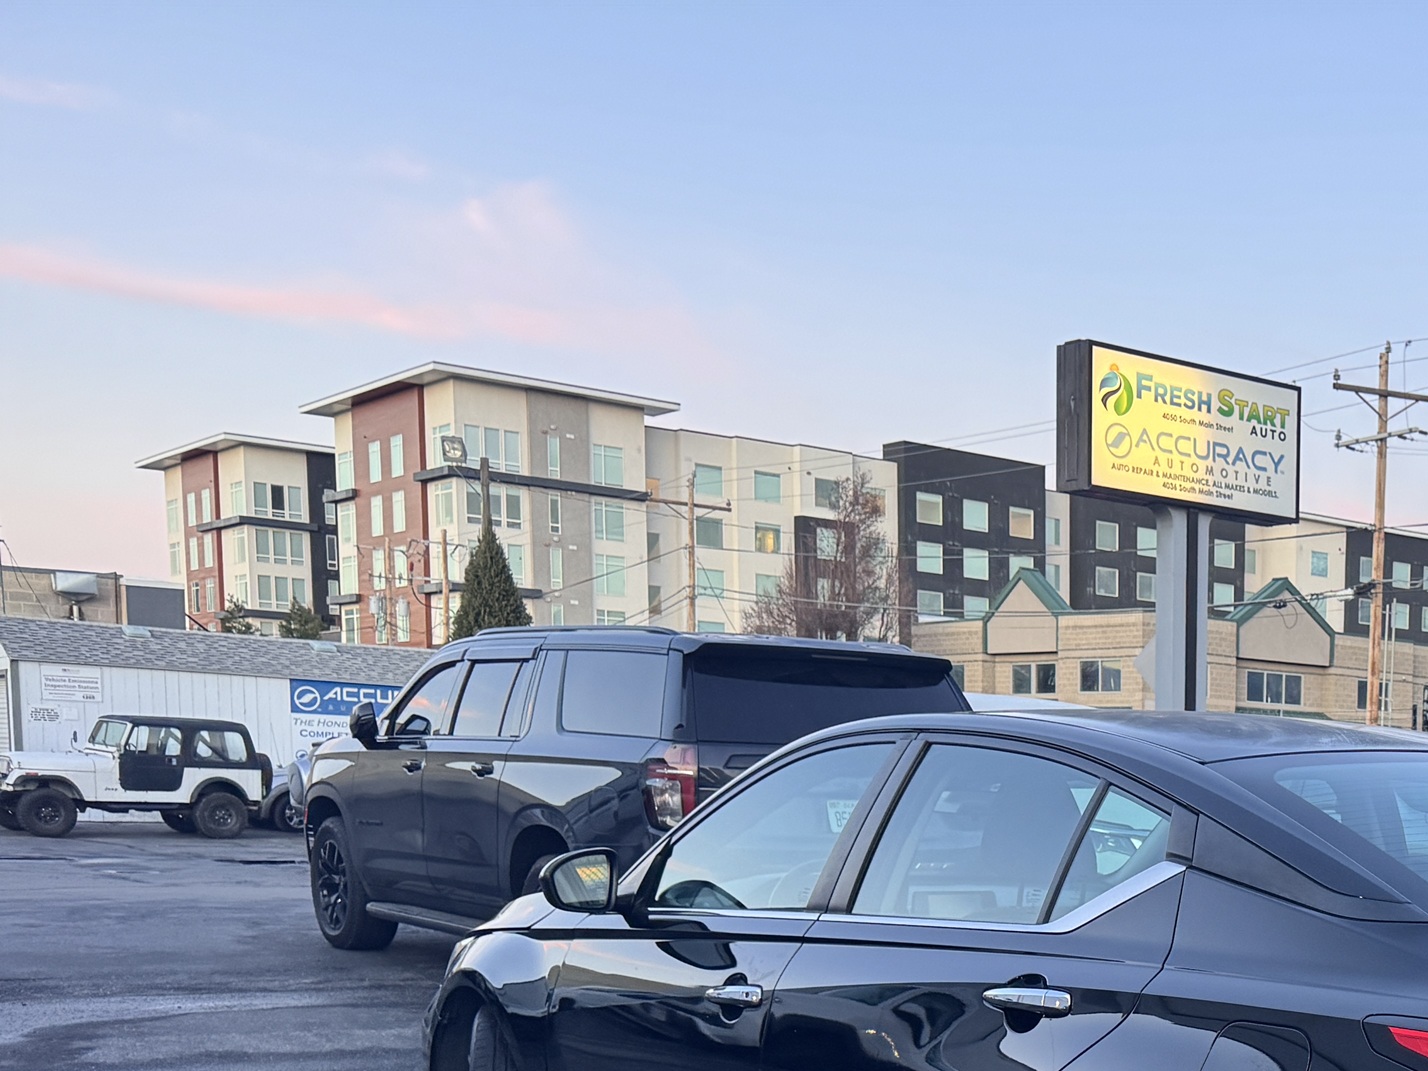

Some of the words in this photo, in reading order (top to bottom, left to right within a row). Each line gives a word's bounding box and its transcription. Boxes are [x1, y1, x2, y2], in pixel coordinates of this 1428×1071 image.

[1136, 372, 1212, 414] FRESH
[1217, 388, 1290, 429] START
[1162, 412, 1178, 422] 4050
[1179, 415, 1197, 426] South
[1198, 419, 1214, 429] Main
[1215, 422, 1234, 433] Street
[1250, 425, 1287, 442] AUTO
[1134, 427, 1285, 475] ACCURACY
[1111, 462, 1130, 473] AUTO
[1131, 466, 1154, 477] REPAIR
[1212, 480, 1223, 489] ALL
[1224, 483, 1246, 493] MAKES
[1153, 456, 1272, 487] AUTOMOTIVE
[1179, 484, 1197, 494] South
[1198, 488, 1214, 497] Main
[1215, 490, 1234, 500] Street
[323, 686, 400, 704] ACCU
[293, 717, 315, 727] THE
[317, 718, 349, 728] HOND
